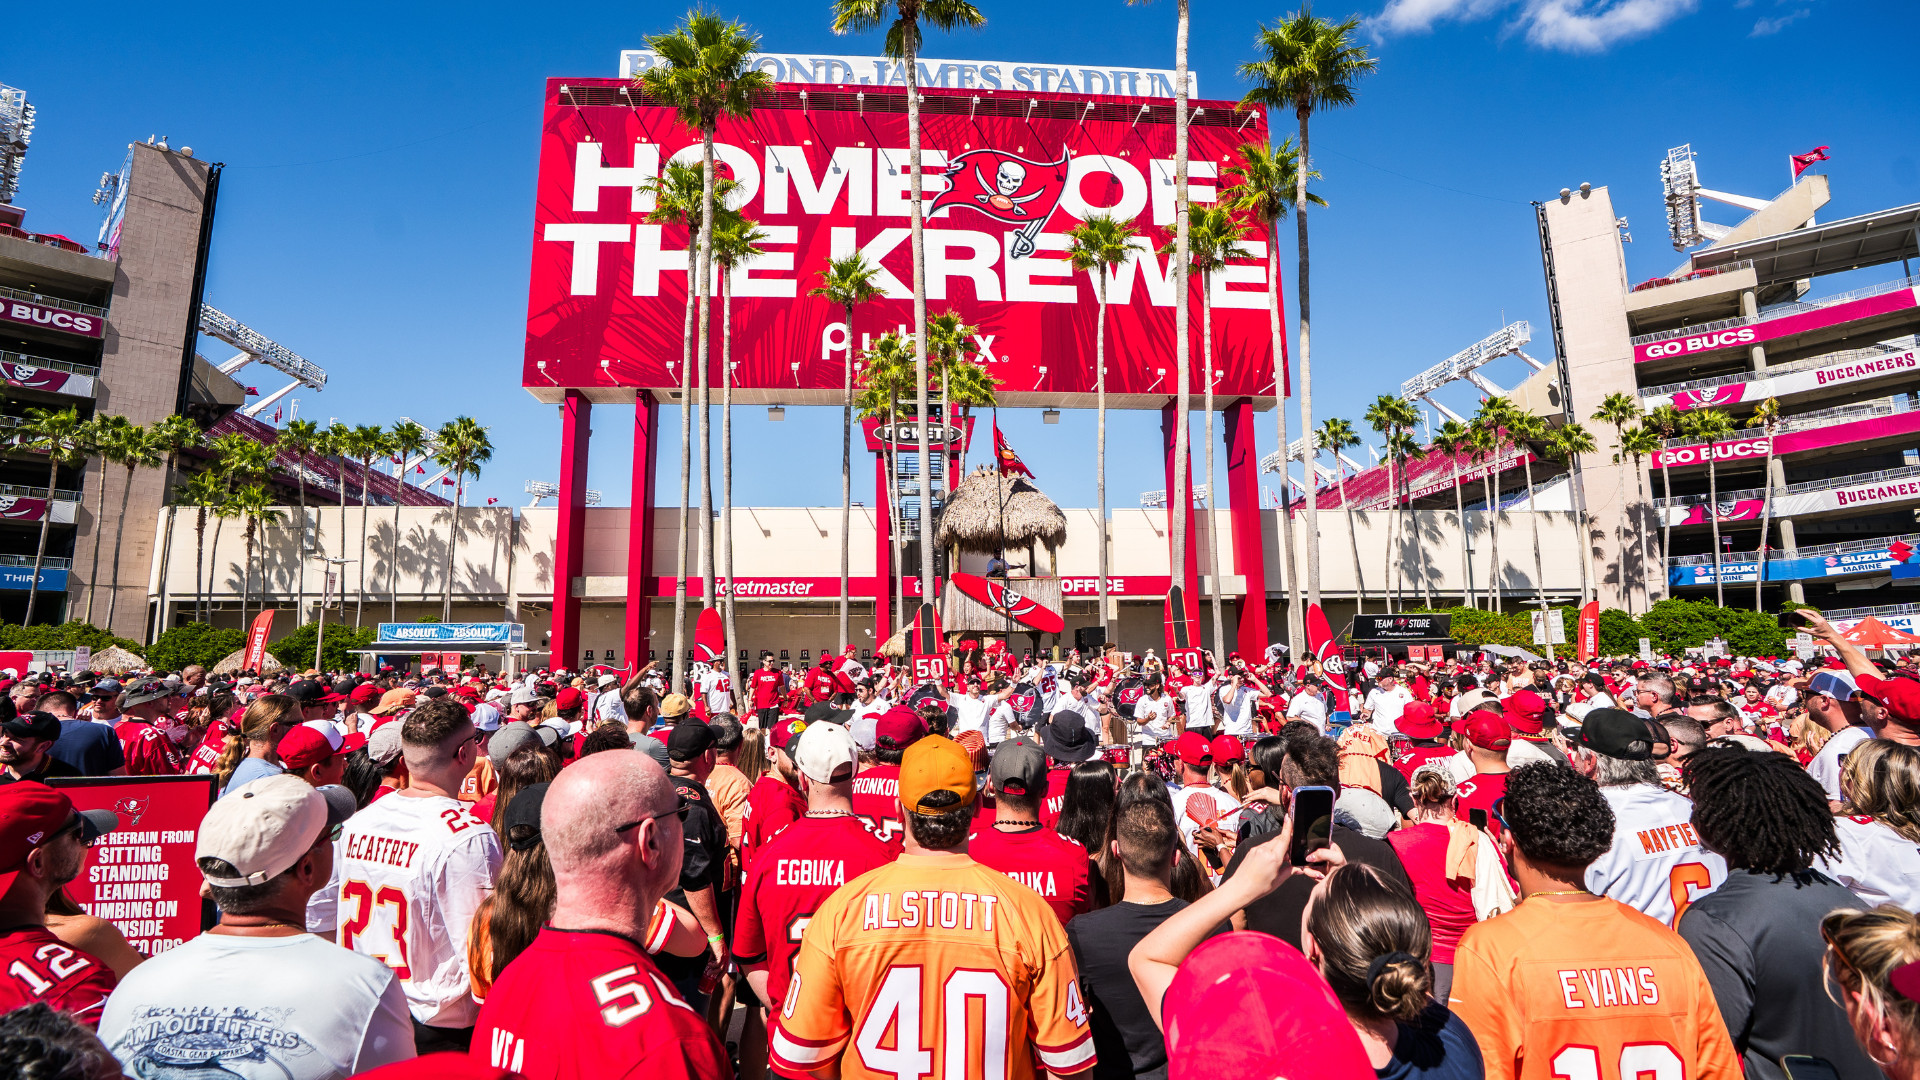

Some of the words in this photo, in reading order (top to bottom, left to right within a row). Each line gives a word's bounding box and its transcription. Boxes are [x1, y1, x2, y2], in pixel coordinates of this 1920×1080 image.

[625, 53, 854, 85] ROND
[859, 60, 1001, 90] JAMES
[572, 142, 949, 217] HOME
[1059, 154, 1217, 226] OF
[543, 223, 798, 298] THE
[830, 227, 1271, 310] KREWE
[11, 304, 92, 332] BUCS
[1646, 341, 1682, 358] GO
[1686, 328, 1755, 352] BUCS
[1816, 352, 1916, 385] BUCCANEERS
[884, 426, 955, 440] TCKET
[1658, 449, 1695, 465] GO
[1700, 440, 1769, 461] BUCS
[1490, 459, 1517, 474] GUBER
[1836, 481, 1920, 506] BUCCANEE
[1840, 551, 1894, 564] SUZUK
[1709, 574, 1744, 582] MRINE
[1843, 563, 1883, 573] MARINE
[715, 579, 814, 595] icetmaster
[1061, 578, 1125, 592] OFFICE
[1374, 619, 1393, 629] TEAM
[1408, 618, 1431, 629] STORE
[1586, 624, 1595, 653] EXPRESS
[916, 658, 944, 678] 50
[715, 678, 731, 693] 42
[1041, 675, 1056, 693] 25
[851, 777, 900, 798] RONKOW
[109, 831, 158, 845] REFRAIN
[161, 830, 194, 844] FROM
[98, 845, 162, 864] SITTING
[89, 864, 169, 882] STANDING
[776, 859, 845, 886] EGBUKA
[94, 882, 162, 901] LEANING
[154, 900, 178, 917] ON
[863, 890, 998, 931] ALSTOTT
[341, 877, 412, 980] 23
[7, 942, 92, 998] 12
[1557, 966, 1659, 1009] EVANS
[853, 963, 1011, 1080] 40
[123, 1020, 161, 1048] AMI
[164, 1016, 299, 1049] OUTFITTERS
[157, 1044, 187, 1059] COASTAL
[188, 1050, 208, 1059] GEAR
[217, 1047, 249, 1059] APPAREL
